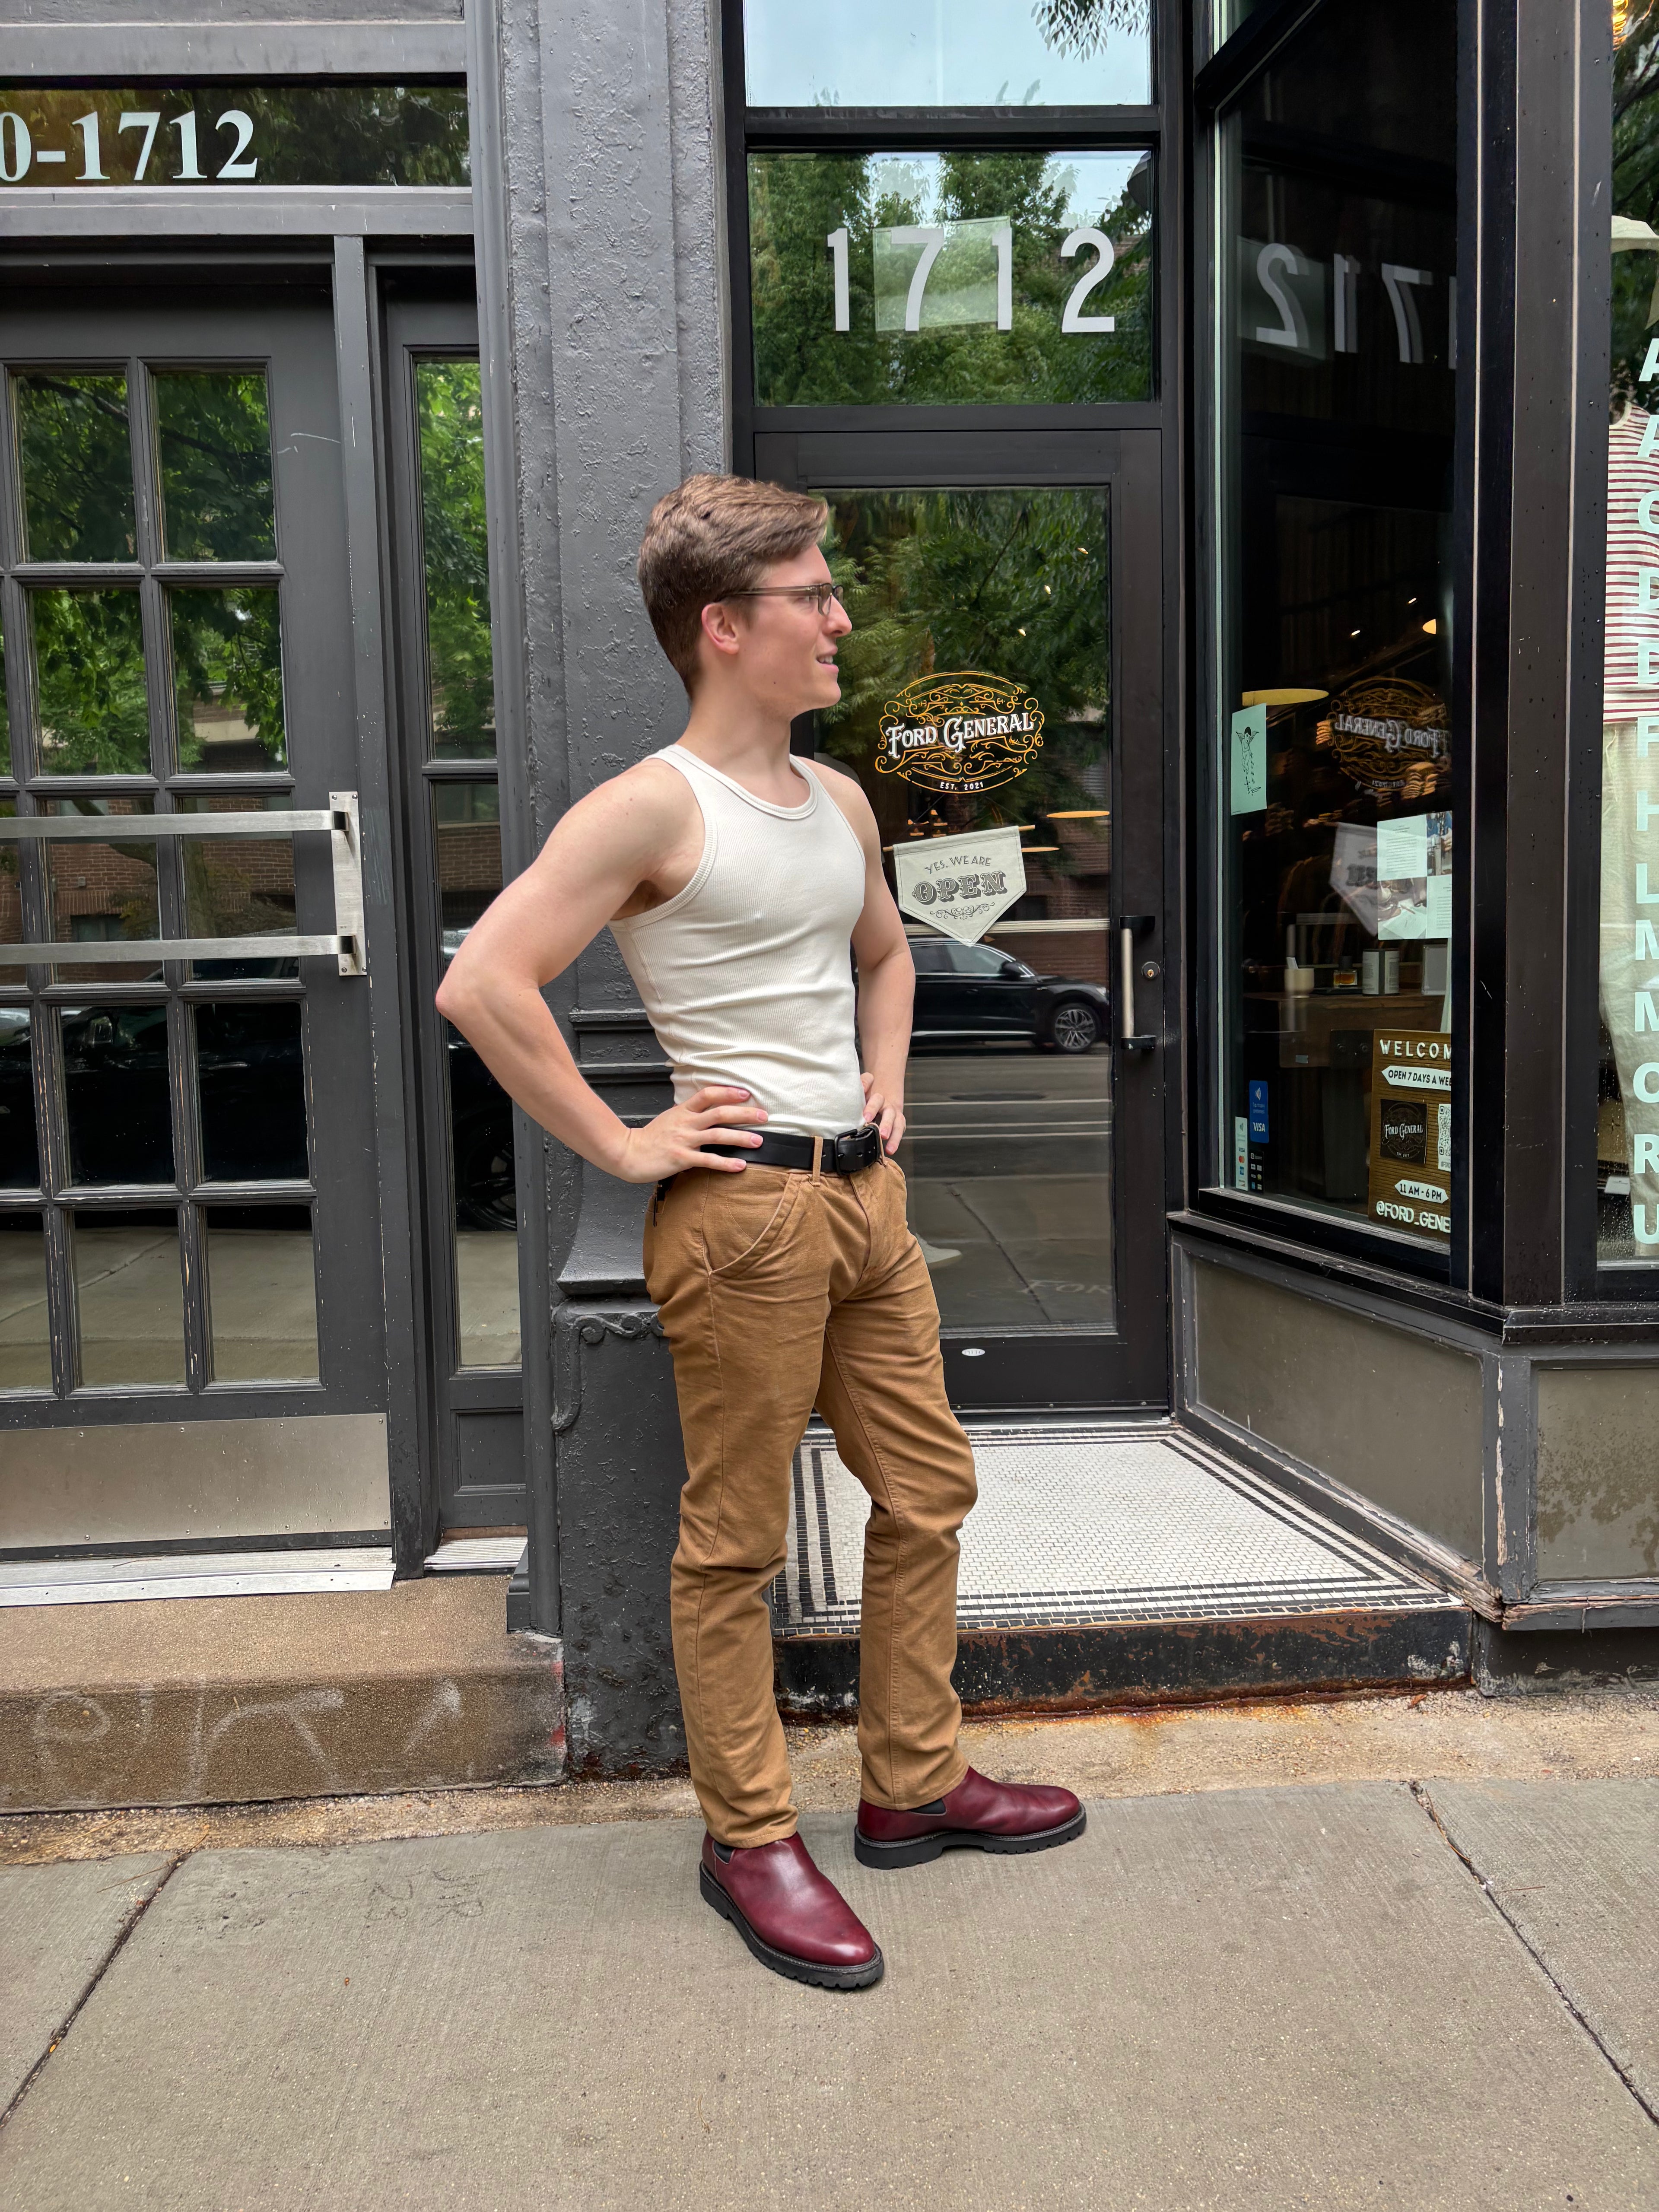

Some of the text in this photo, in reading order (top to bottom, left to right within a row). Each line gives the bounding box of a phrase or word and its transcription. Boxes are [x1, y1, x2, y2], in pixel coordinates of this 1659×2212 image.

[0, 110, 257, 182] 0-1712
[826, 227, 1115, 334] 1712
[886, 712, 1035, 760] FORD GENERAL
[940, 781, 984, 791] EST. 2021
[949, 855, 969, 866] WE
[971, 855, 992, 867] ARE
[912, 870, 1008, 906] OPEN
[1388, 1069, 1407, 1080] OPEN
[1407, 1072, 1412, 1081] 7
[1413, 1073, 1430, 1084] DAYS
[1431, 1075, 1437, 1084] A
[1253, 1122, 1265, 1132] VISA
[1384, 1122, 1424, 1140] FORD GENERAL
[1400, 1183, 1407, 1193] 11
[1408, 1185, 1420, 1196] AM
[1426, 1188, 1430, 1198] 6
[1431, 1189, 1442, 1201] PM
